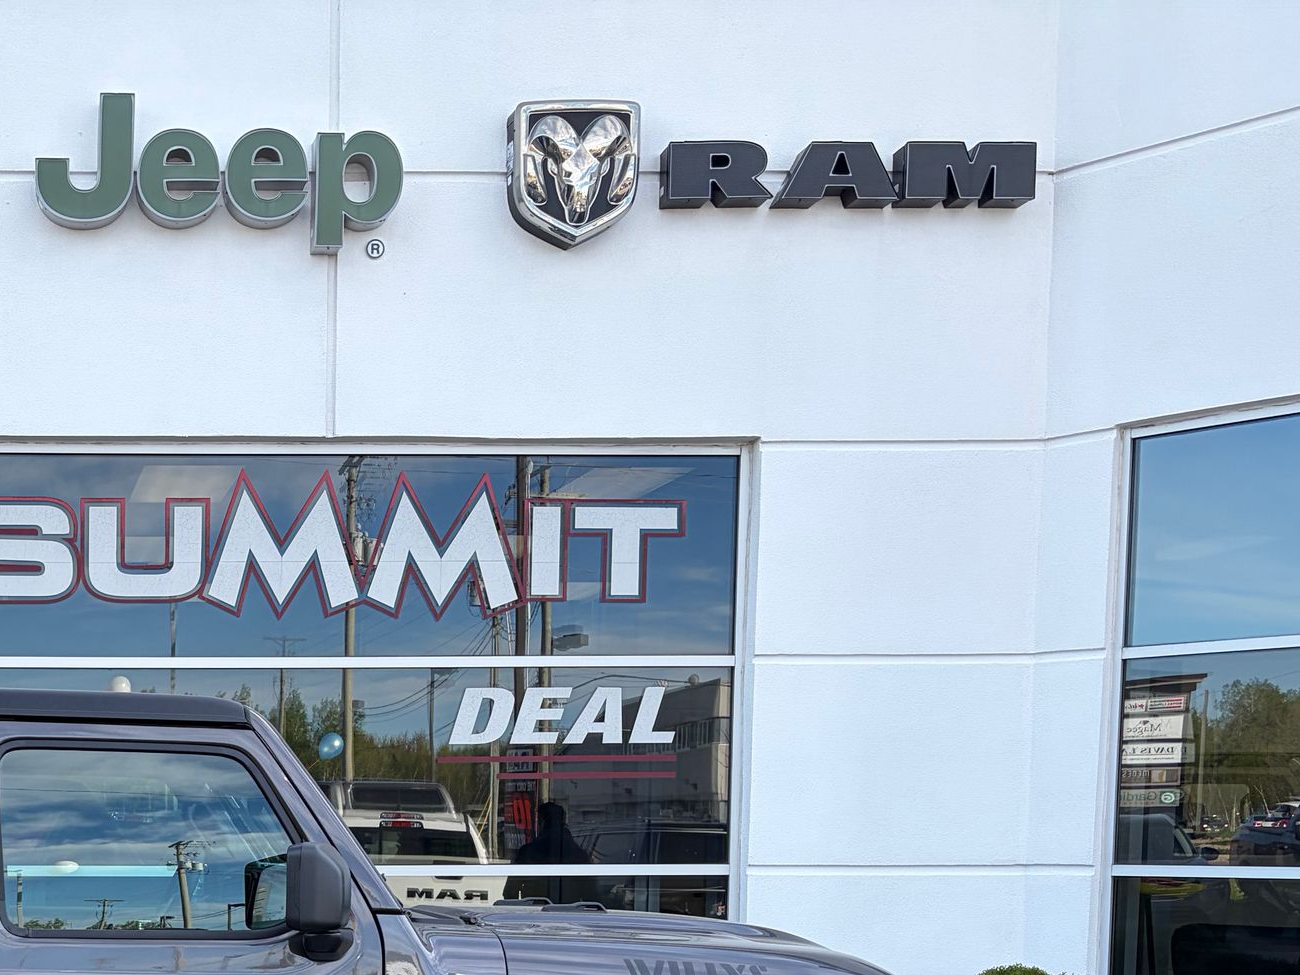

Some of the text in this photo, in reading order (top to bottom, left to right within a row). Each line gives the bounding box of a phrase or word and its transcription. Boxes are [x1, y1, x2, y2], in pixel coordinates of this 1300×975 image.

[34, 92, 404, 256] Jeep
[659, 140, 1038, 209] RAM
[448, 686, 676, 746] DEAL
